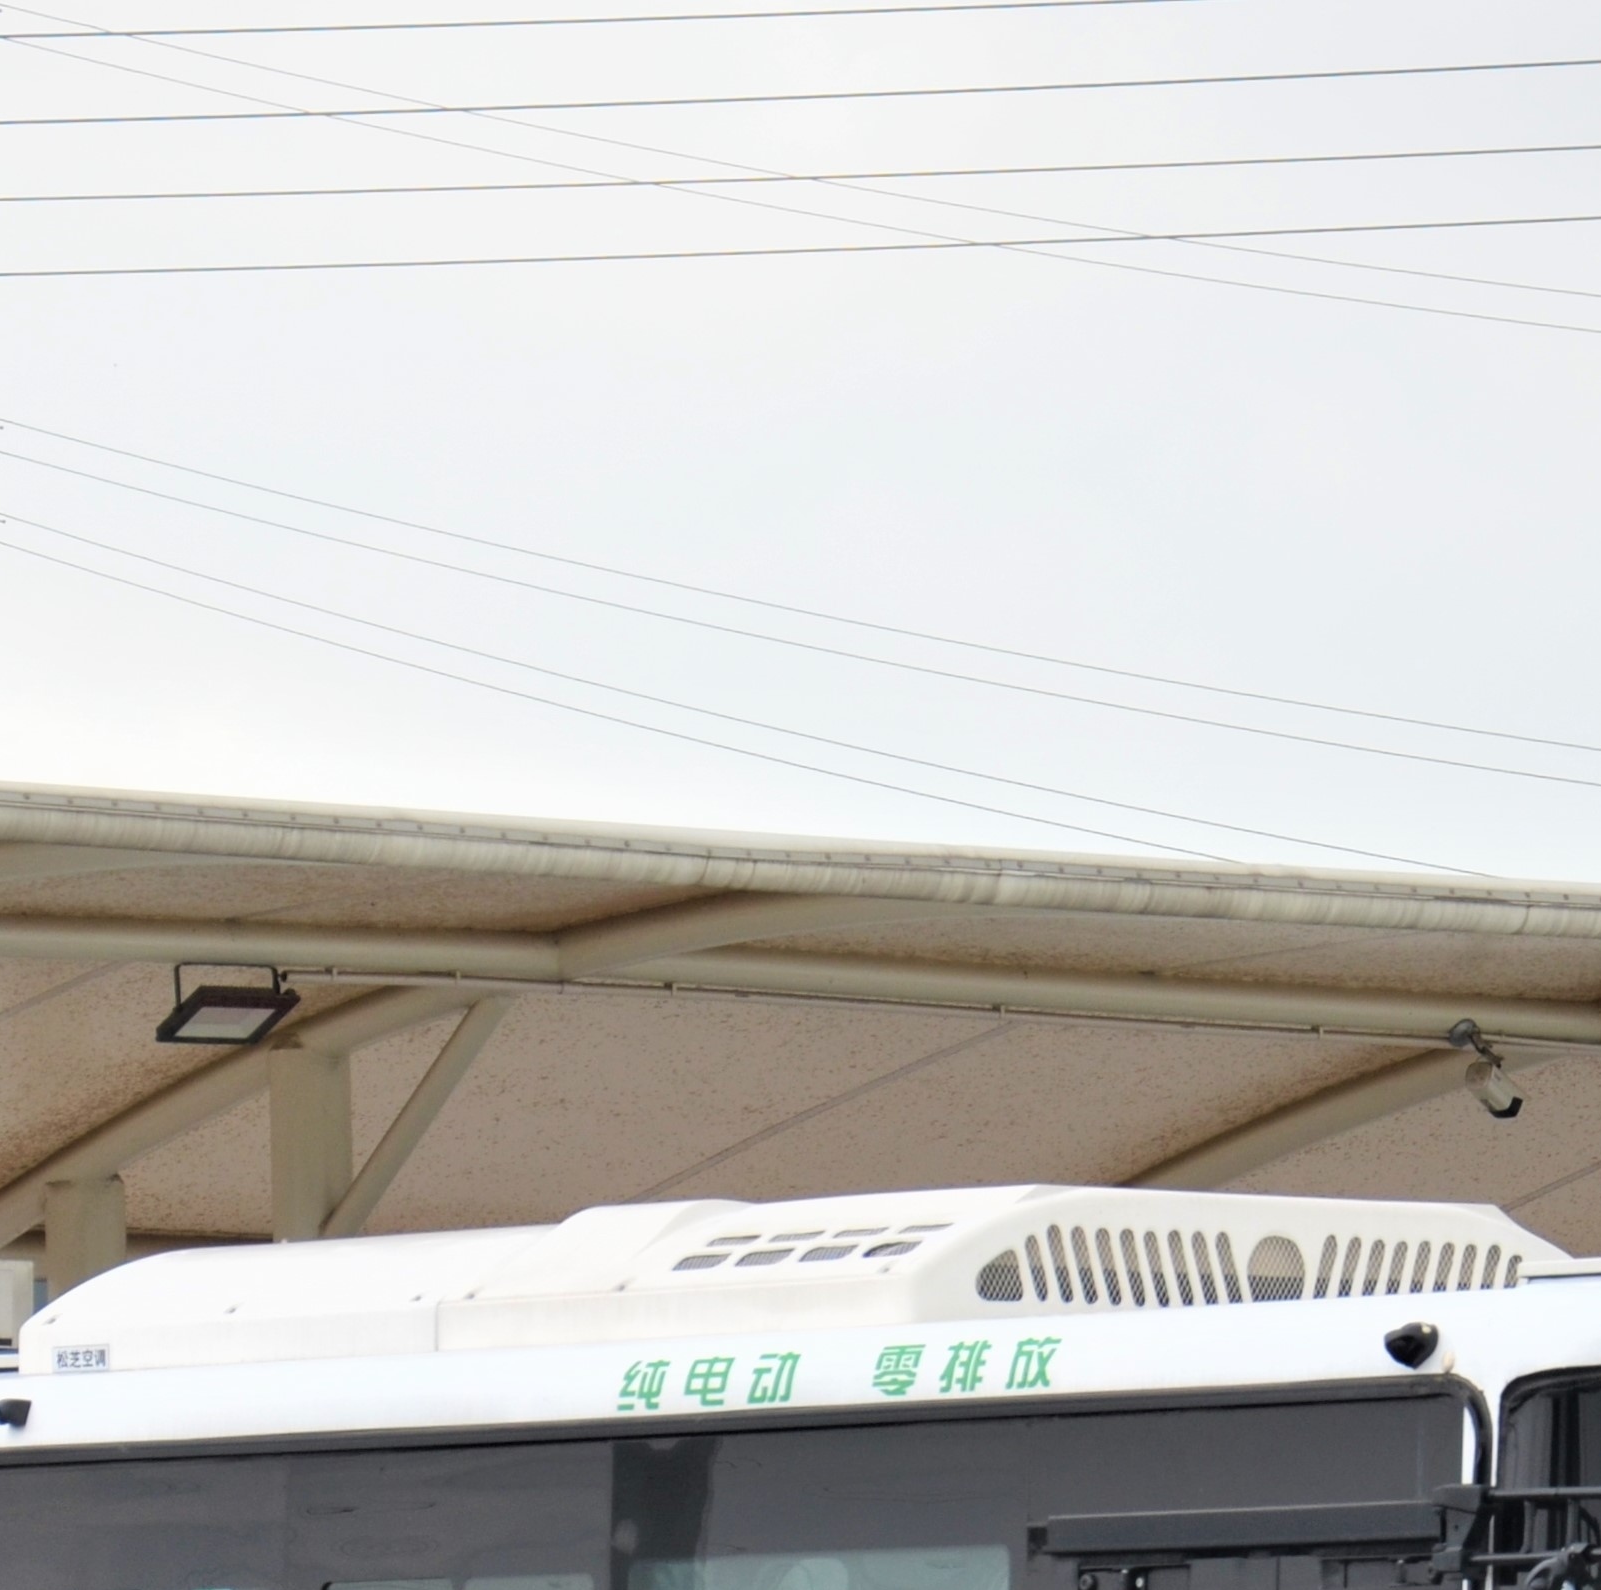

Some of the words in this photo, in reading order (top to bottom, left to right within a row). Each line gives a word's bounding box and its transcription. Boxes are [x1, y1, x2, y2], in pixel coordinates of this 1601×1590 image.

[56, 1349, 107, 1369] 松芝空调
[617, 1351, 802, 1411] 纯电动
[872, 1336, 1062, 1396] 零排放
